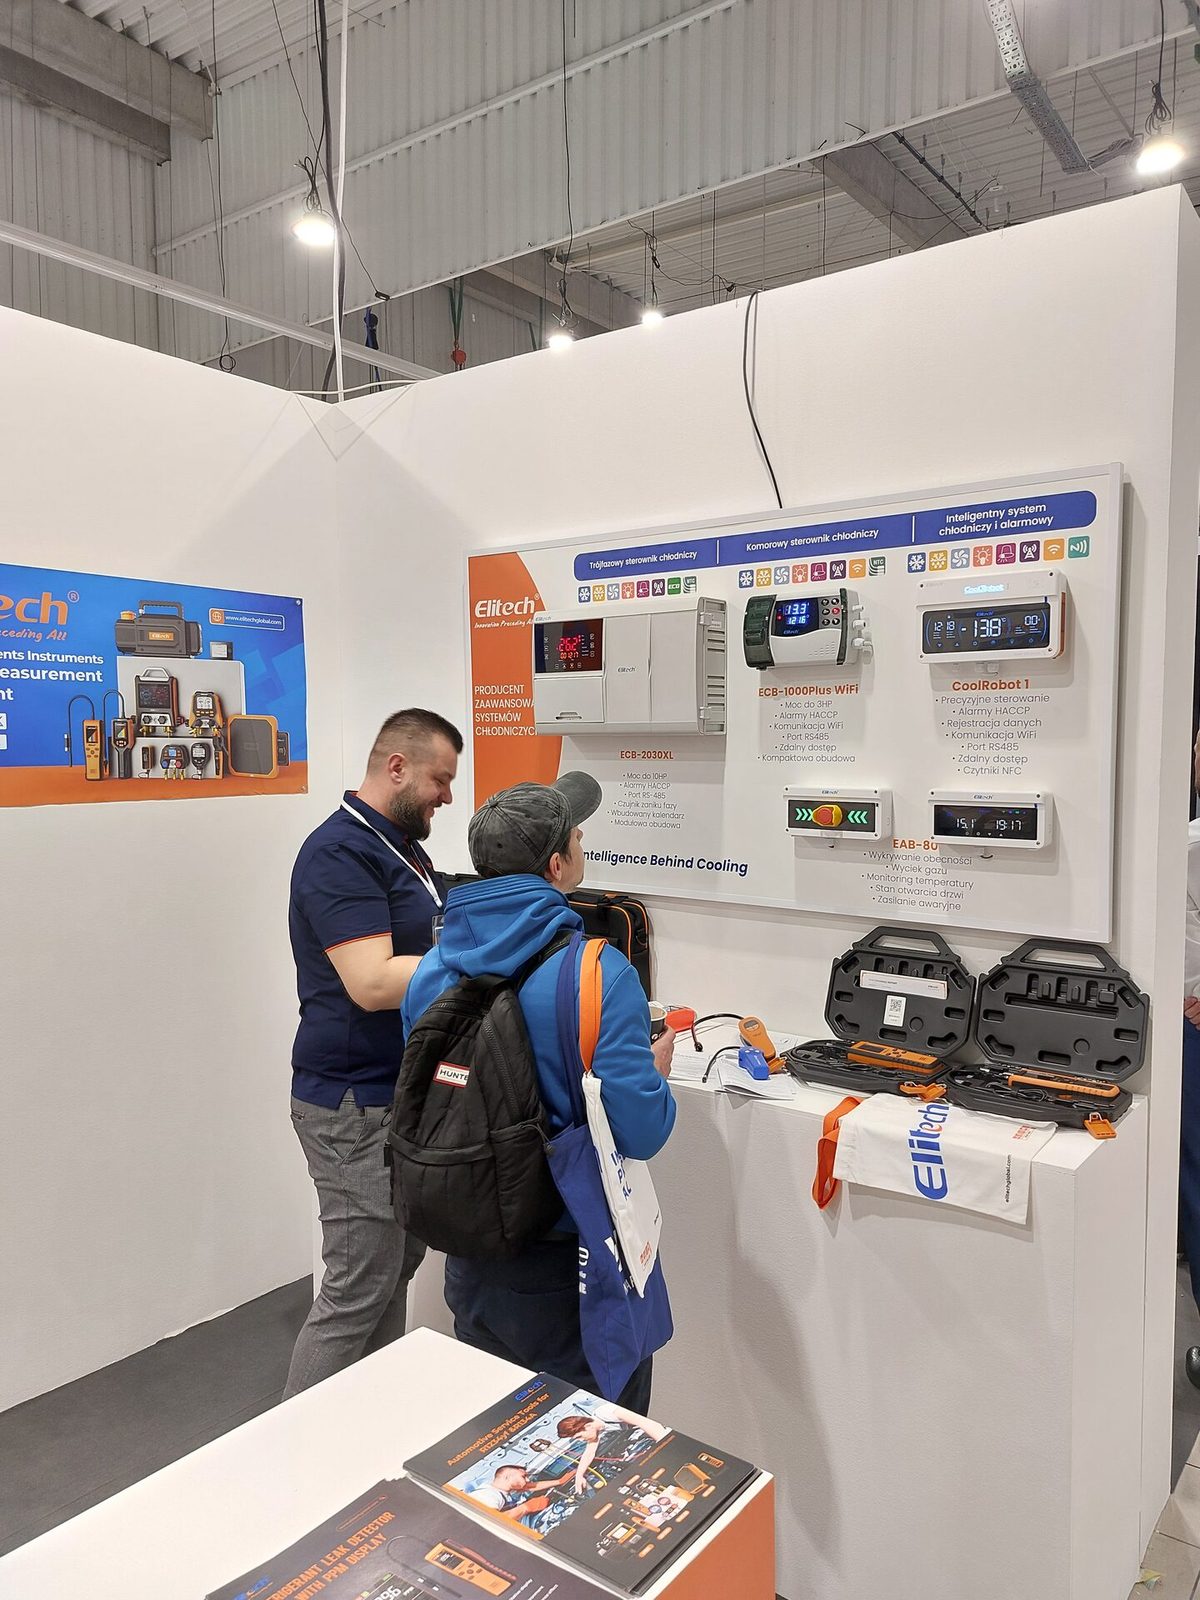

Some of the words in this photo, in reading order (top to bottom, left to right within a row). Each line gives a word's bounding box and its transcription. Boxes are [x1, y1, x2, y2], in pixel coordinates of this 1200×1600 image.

[946, 508, 1005, 524] Inteligentny
[1007, 503, 1046, 517] system
[939, 521, 991, 537] chłodniczy
[1000, 514, 1054, 530] alarmowy
[746, 541, 788, 551] Komorowy
[790, 534, 830, 546] sterownik
[832, 528, 879, 543] chłodniczy
[589, 560, 624, 570] Trójfazowy
[625, 554, 658, 566] sterownik
[659, 551, 698, 563] chłodniczy
[474, 596, 535, 617] Elitech
[0, 628, 42, 642] ceding
[28, 650, 104, 664] Instruments
[474, 685, 524, 695] PRODUCENT
[758, 686, 832, 697] ECB-1000Plus
[834, 683, 859, 695] WiFi
[952, 680, 1021, 691] CoolRobot
[1024, 679, 1029, 689] 1
[785, 701, 802, 709] Moc
[817, 700, 832, 708] 3HP
[941, 695, 991, 706] Precyzyjne
[994, 693, 1050, 704] sterowanie
[475, 710, 521, 722] SYSTEMÓW
[779, 711, 807, 721] Alarmy
[810, 711, 838, 719] HACCP
[958, 707, 992, 717] Alarmy
[995, 706, 1031, 715] HACCP
[774, 722, 825, 731] Komunikacja
[827, 722, 844, 730] WiFi
[947, 719, 1000, 729] Rejestracja
[1003, 718, 1042, 729] danych
[787, 733, 802, 741] Port
[951, 731, 1014, 741] Komunikacja
[1017, 730, 1037, 739] WiFi
[779, 744, 806, 752] Zdalny
[808, 743, 837, 752] dostęp
[967, 743, 986, 751] Port
[988, 743, 1019, 751] RS485
[620, 751, 674, 760] ECB-2030XL
[762, 754, 813, 763] Kompaktowa
[816, 754, 856, 763] obudowa
[958, 754, 990, 765] Zdalny
[992, 755, 1028, 765] dostęp
[963, 766, 1000, 776] Czytniki
[1002, 767, 1022, 775] NFC
[623, 782, 646, 790] Alarmy
[648, 782, 671, 790] HACCP
[617, 801, 640, 809] Czujnik
[641, 801, 662, 809] zaniku
[663, 803, 677, 811] fazy
[611, 810, 651, 820] Wbudowany
[652, 811, 685, 820] kalendarz
[614, 819, 648, 828] Modułowa
[649, 821, 681, 829] obudowa
[583, 850, 648, 866] ntelligence
[650, 854, 694, 868] Behind
[696, 858, 748, 877] Cooling
[869, 852, 921, 863] Wykrywanie
[923, 854, 972, 866] obecności
[891, 864, 922, 873] Wyciek
[924, 867, 948, 876] gazu
[867, 873, 913, 886] Monitoring
[915, 877, 974, 890] temperatury
[875, 884, 896, 893] Stan
[897, 887, 938, 897] otwarcia
[940, 890, 964, 899] drzwi
[877, 896, 917, 907] Zasilanie
[918, 900, 961, 911] awaryjne
[908, 1103, 950, 1200] Elitech
[448, 1433, 494, 1466] Automotive
[492, 1413, 520, 1435] Service
[518, 1400, 539, 1416] Tools
[537, 1392, 549, 1404] for
[320, 1544, 350, 1567] LEAK
[347, 1511, 396, 1547] DETECTOR
[322, 1562, 349, 1582] PPM
[345, 1532, 387, 1565] DISPLAY
